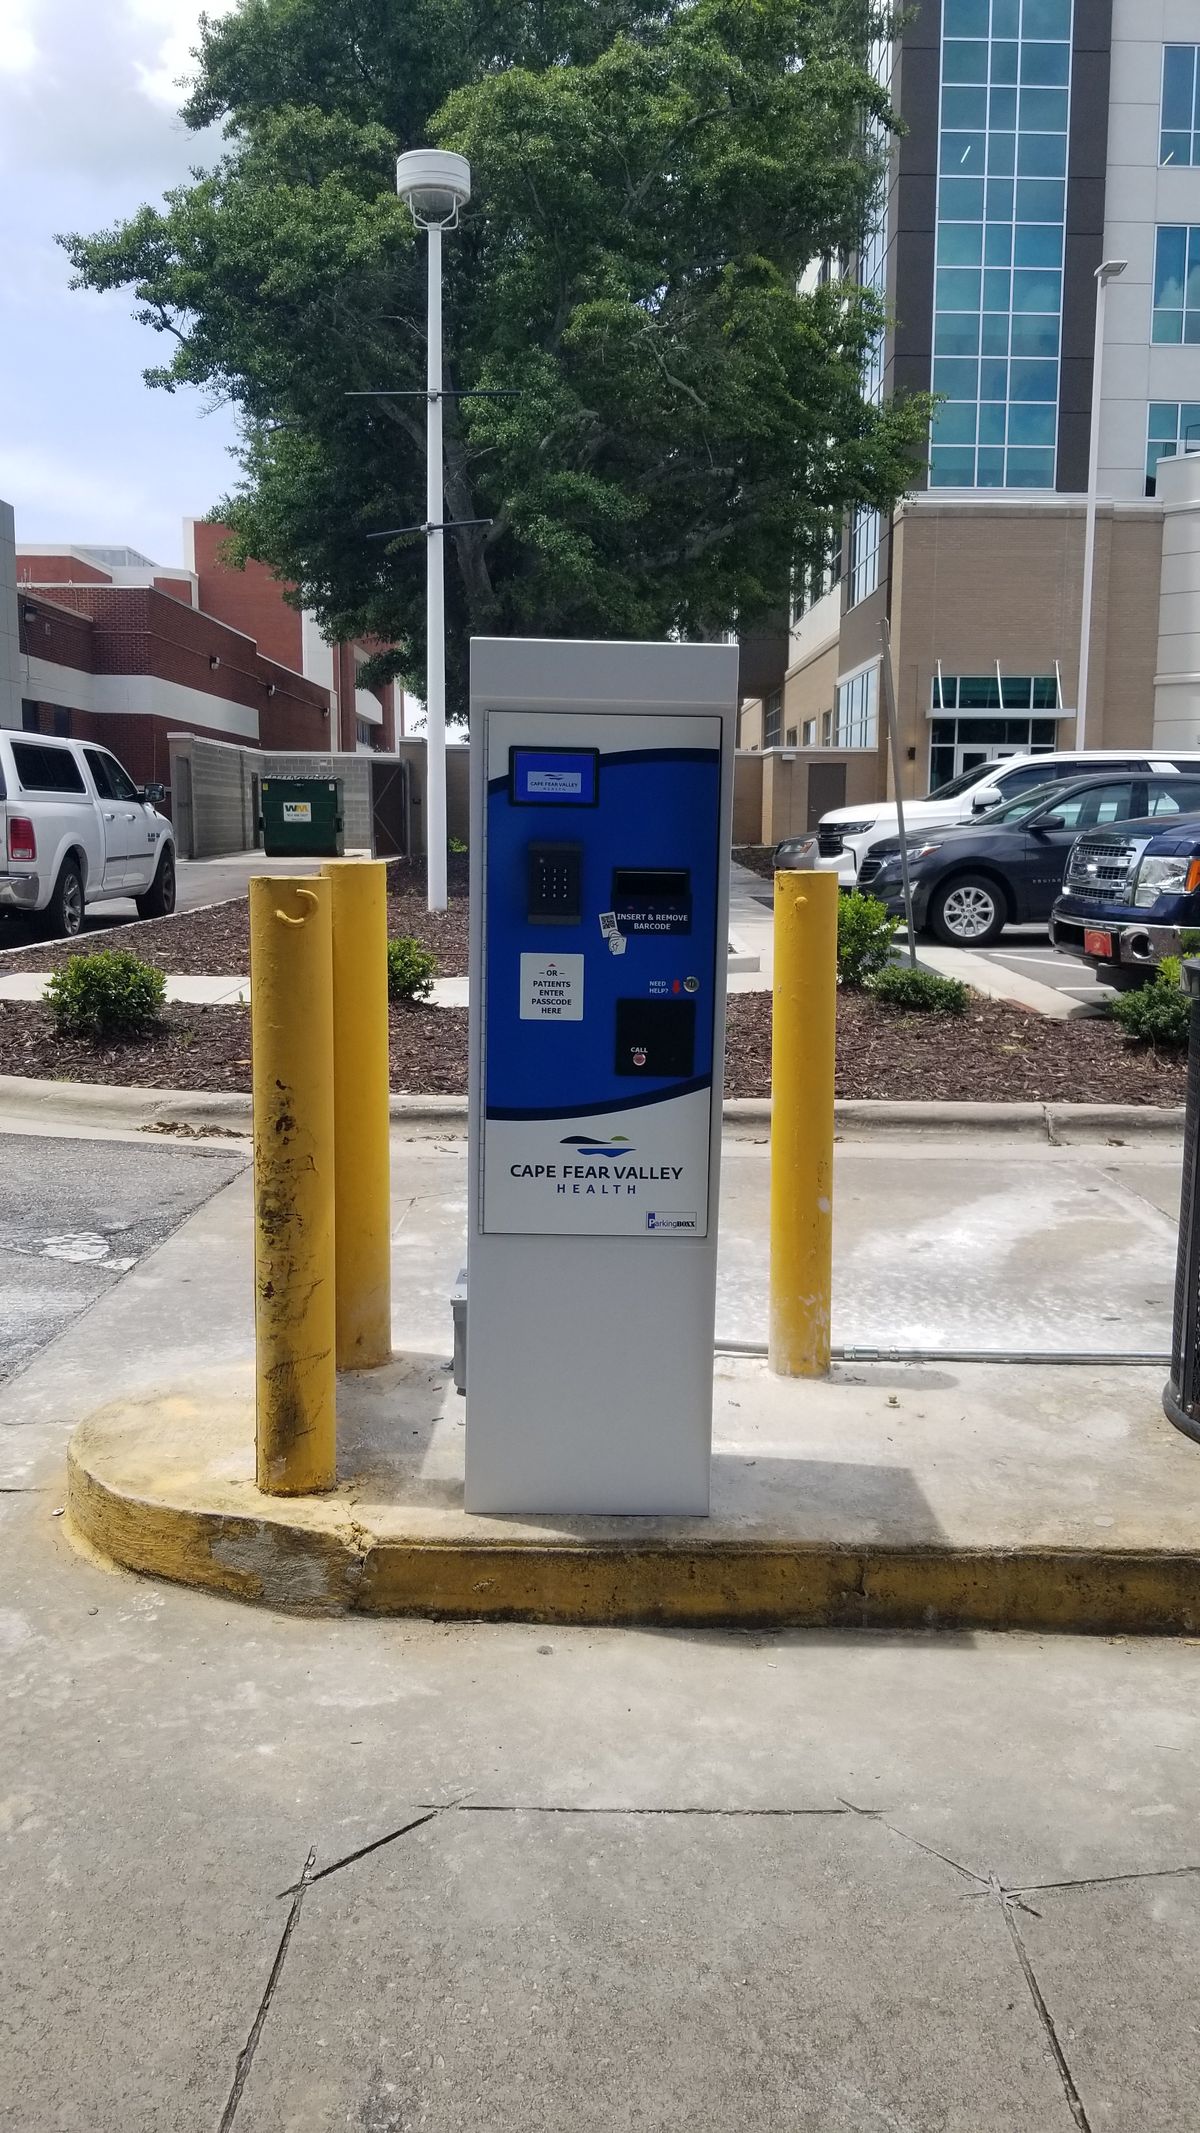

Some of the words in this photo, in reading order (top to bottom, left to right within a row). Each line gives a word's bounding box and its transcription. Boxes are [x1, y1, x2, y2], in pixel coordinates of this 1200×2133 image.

[285, 804, 308, 812] WM
[616, 913, 647, 921] INSERT
[655, 914, 689, 922] REMOVE
[633, 922, 671, 930] BARCODE
[546, 969, 558, 977] OR
[532, 980, 571, 988] PATIENTS
[539, 989, 564, 997] ENTER
[531, 998, 572, 1006] PASSCODE
[510, 1164, 557, 1178] CAPE
[563, 1165, 609, 1179] FEAR
[614, 1166, 684, 1180] VALLEY
[557, 1184, 637, 1195] HEALTH
